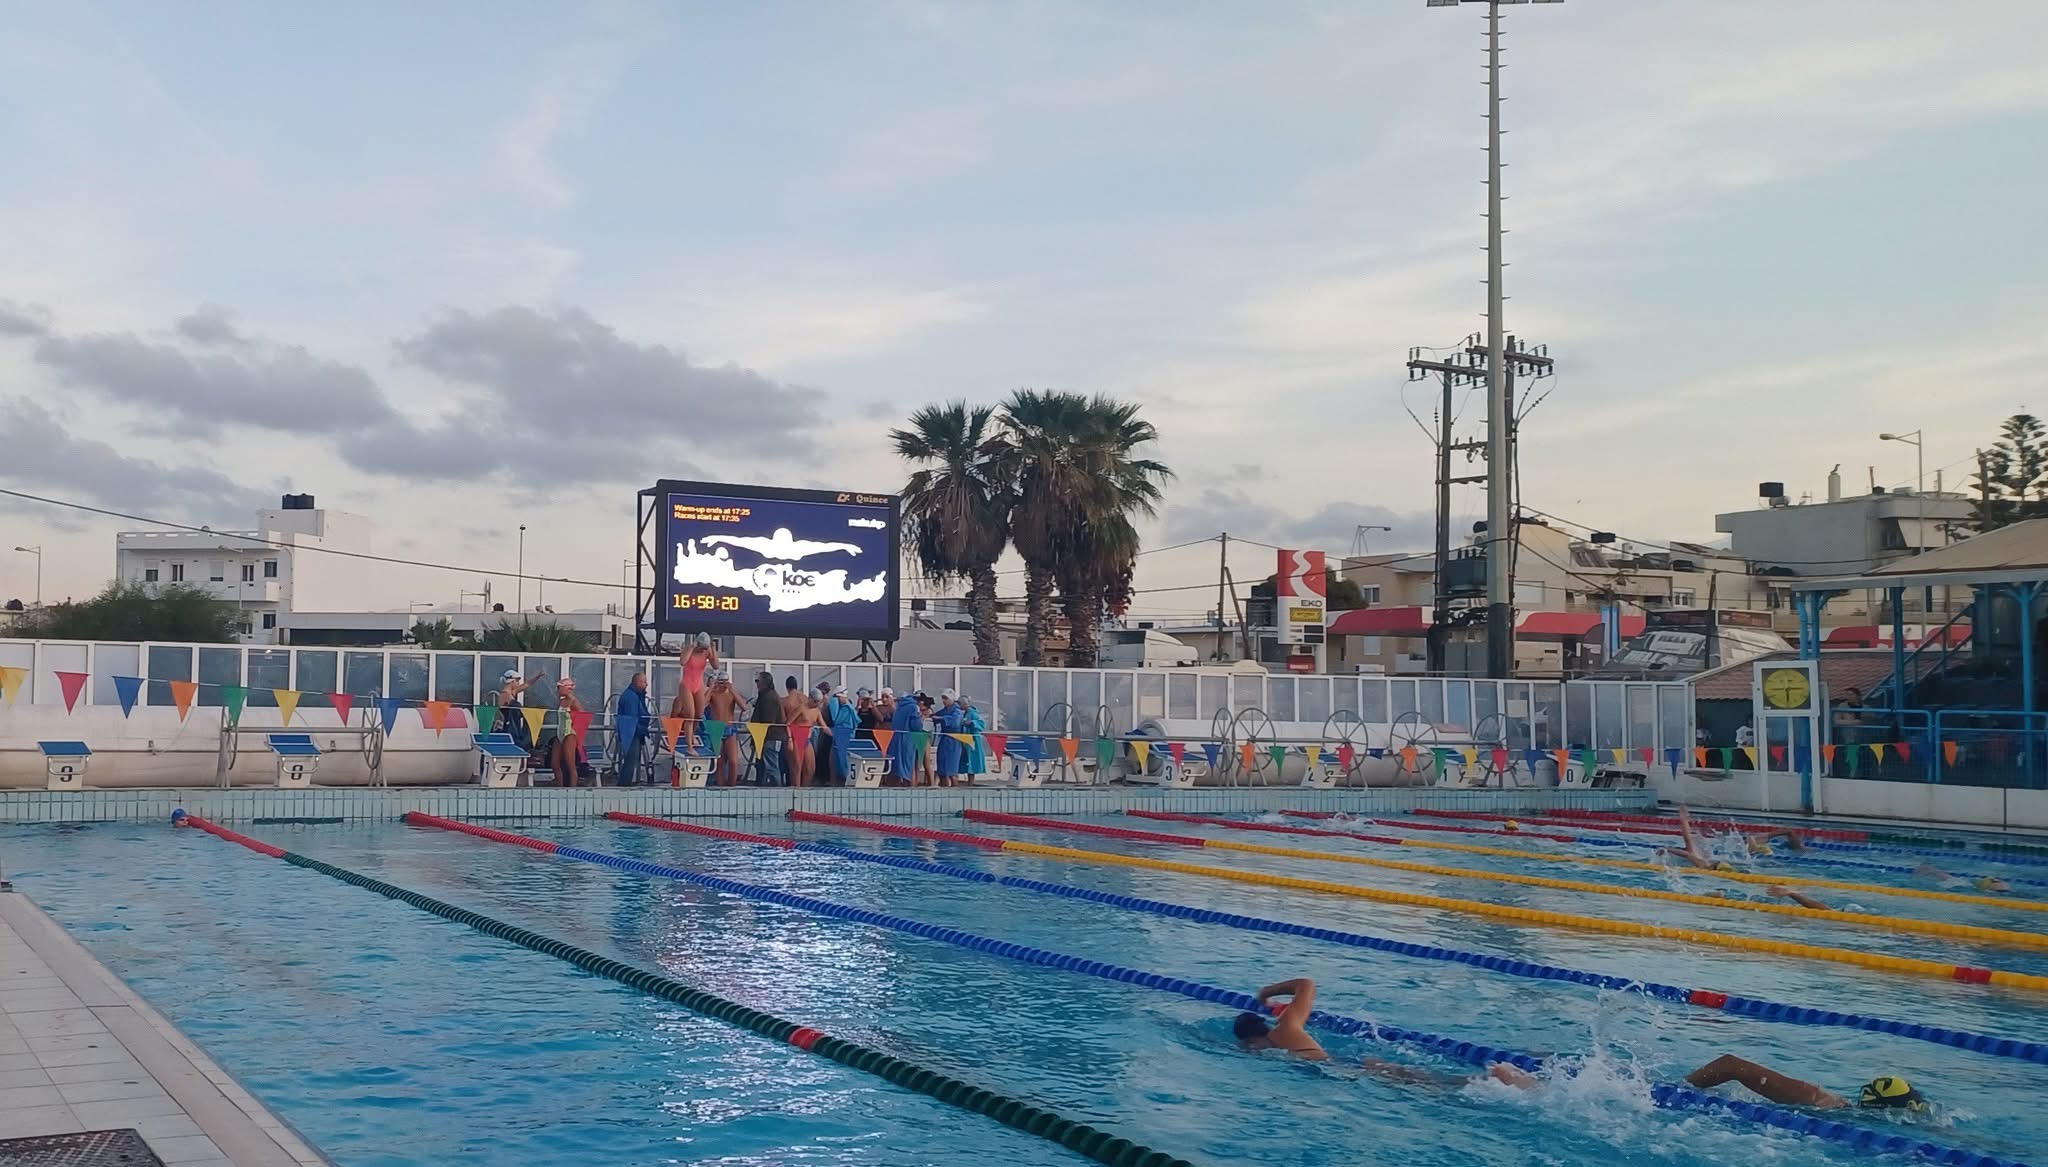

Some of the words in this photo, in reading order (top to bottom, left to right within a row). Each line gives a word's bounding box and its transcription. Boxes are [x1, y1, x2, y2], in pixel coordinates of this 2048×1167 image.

[856, 494, 889, 504] Quince
[673, 594, 739, 611] 16:58:20
[60, 765, 73, 782] 9
[499, 765, 511, 781] 7
[690, 765, 702, 781] 6
[850, 763, 857, 780] 5
[864, 767, 877, 781] 5
[1012, 765, 1019, 780] 4
[1166, 766, 1172, 780] 3
[1443, 767, 1448, 782] 1
[1566, 769, 1574, 783] 0
